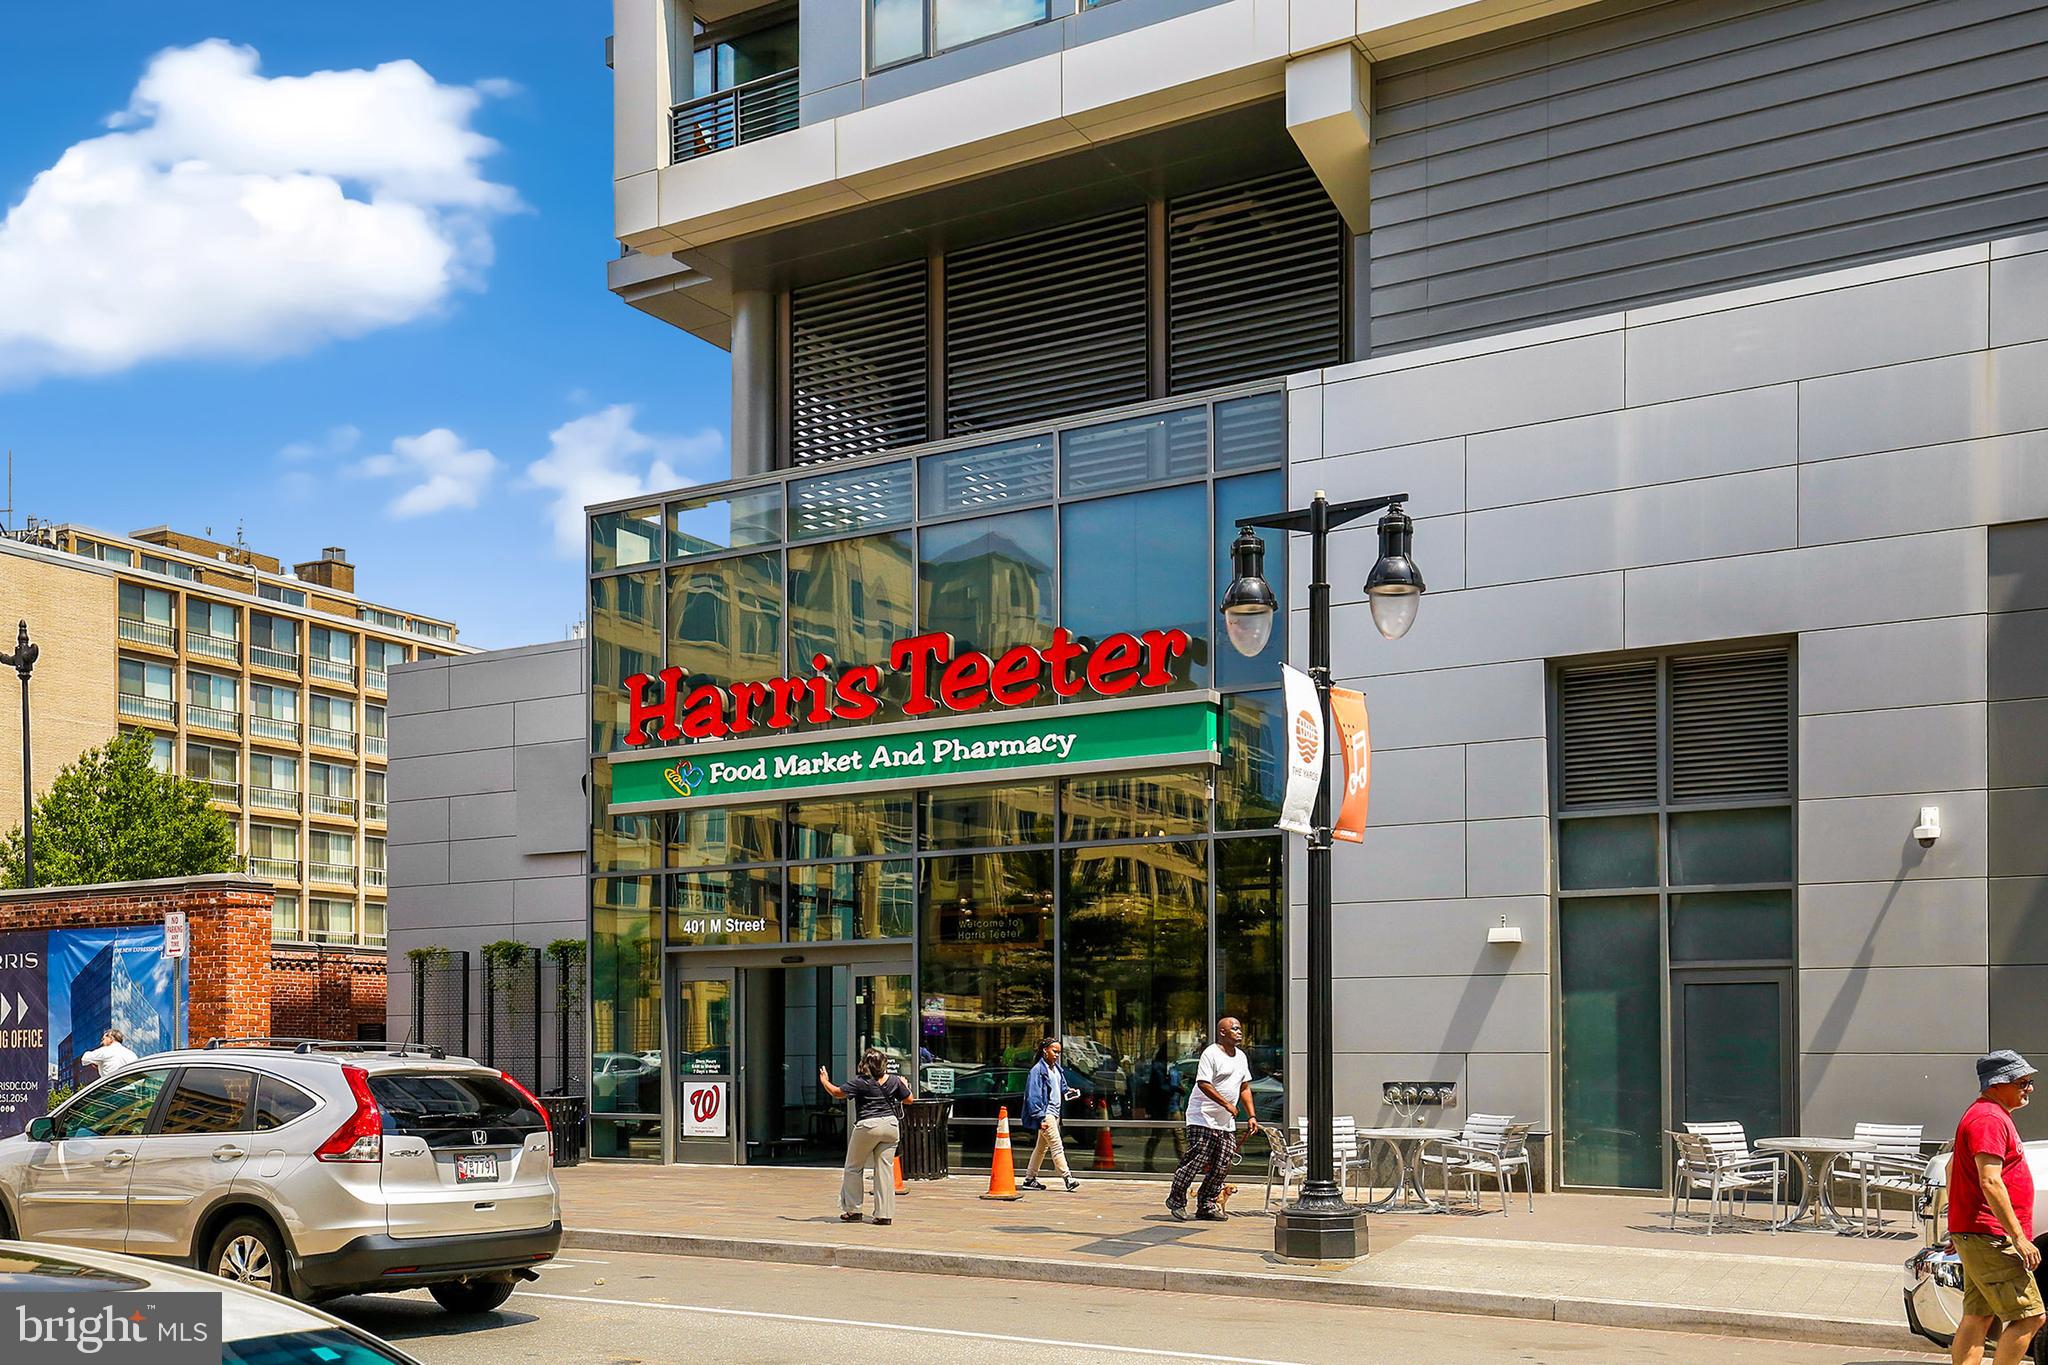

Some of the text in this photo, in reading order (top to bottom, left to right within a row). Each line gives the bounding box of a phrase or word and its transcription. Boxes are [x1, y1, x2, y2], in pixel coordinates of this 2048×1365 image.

[622, 626, 1192, 746] Harris Teeter
[709, 729, 1078, 784] Food Market And Pharmacy
[683, 918, 766, 933] 401 M Street
[959, 920, 1004, 928] Welcome
[958, 930, 1020, 940] Harris Teeter
[0, 953, 39, 969] RIS
[11, 1029, 43, 1048] OFFICE
